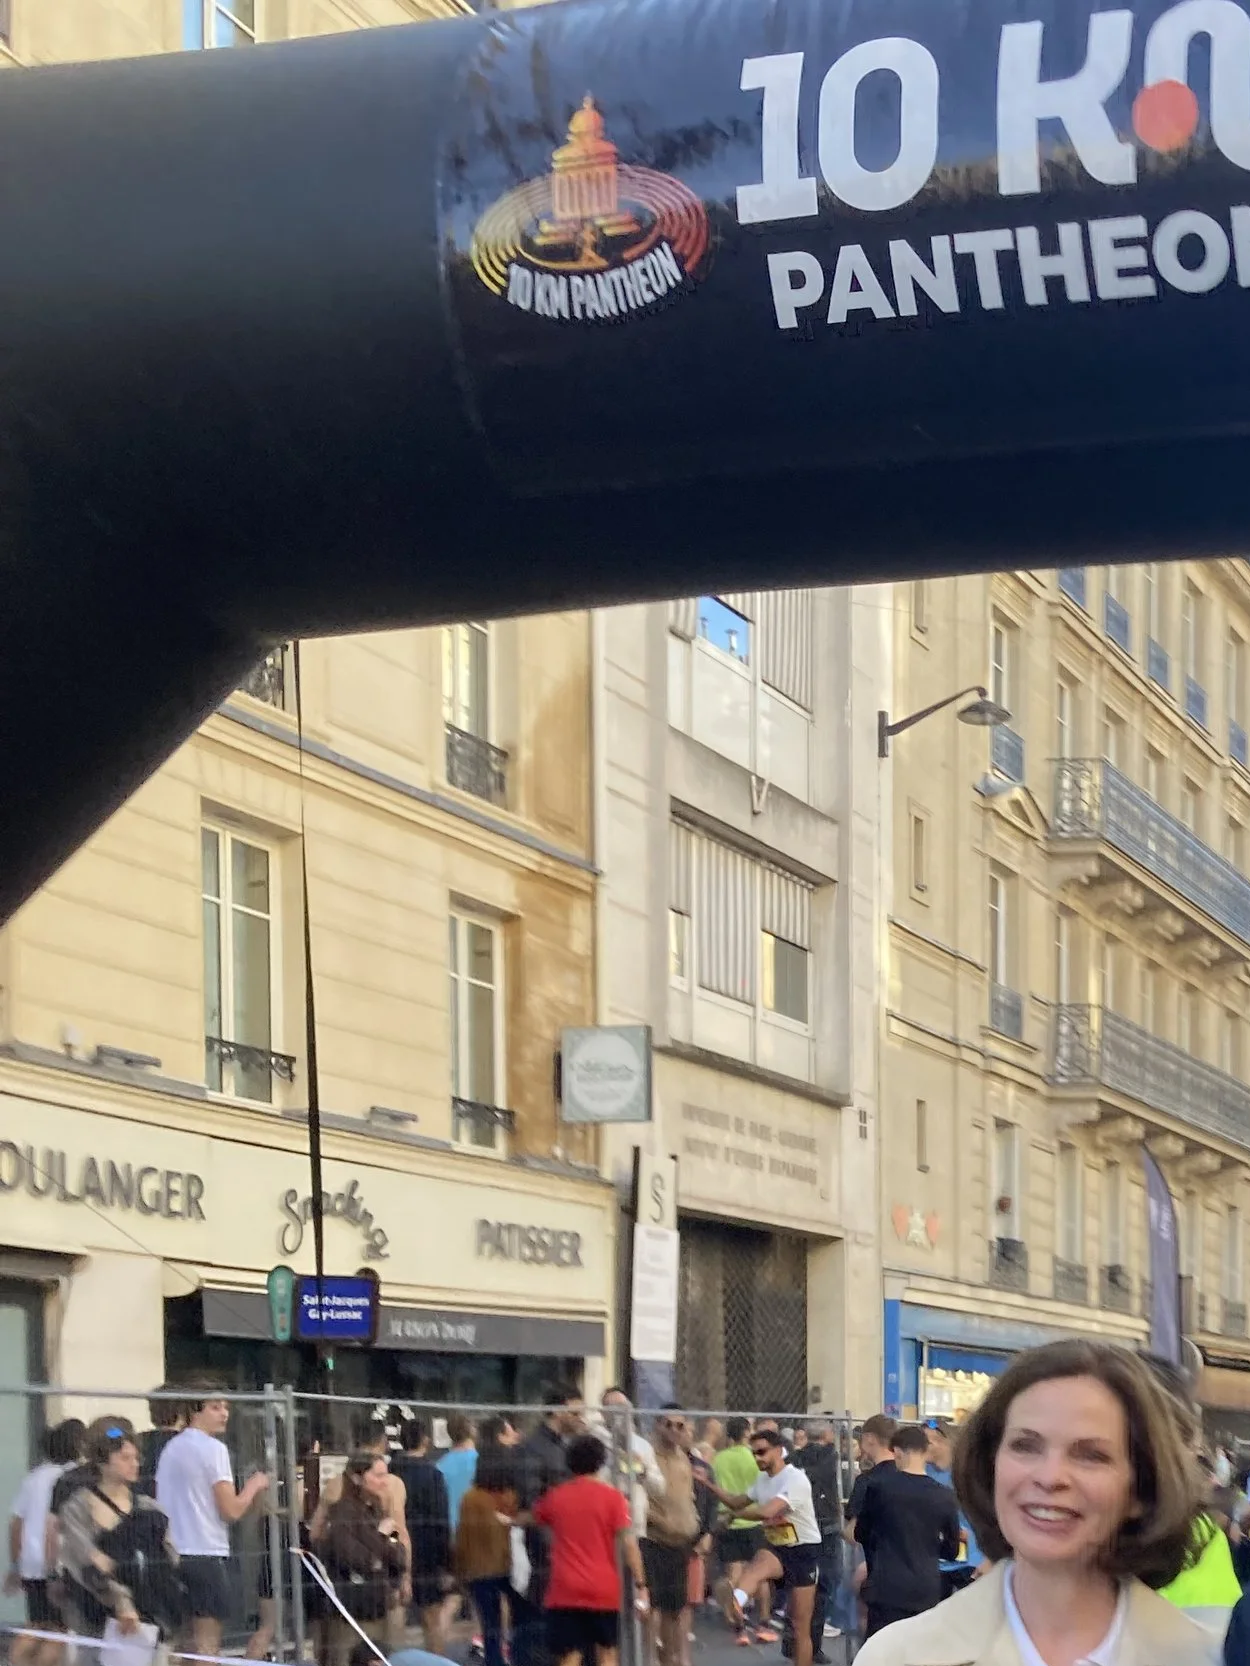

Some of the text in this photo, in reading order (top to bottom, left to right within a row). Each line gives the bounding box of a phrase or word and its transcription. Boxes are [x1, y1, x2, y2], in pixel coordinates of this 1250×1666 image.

[735, 36, 941, 226] 10
[507, 240, 684, 322] 10 KM PANTHEON
